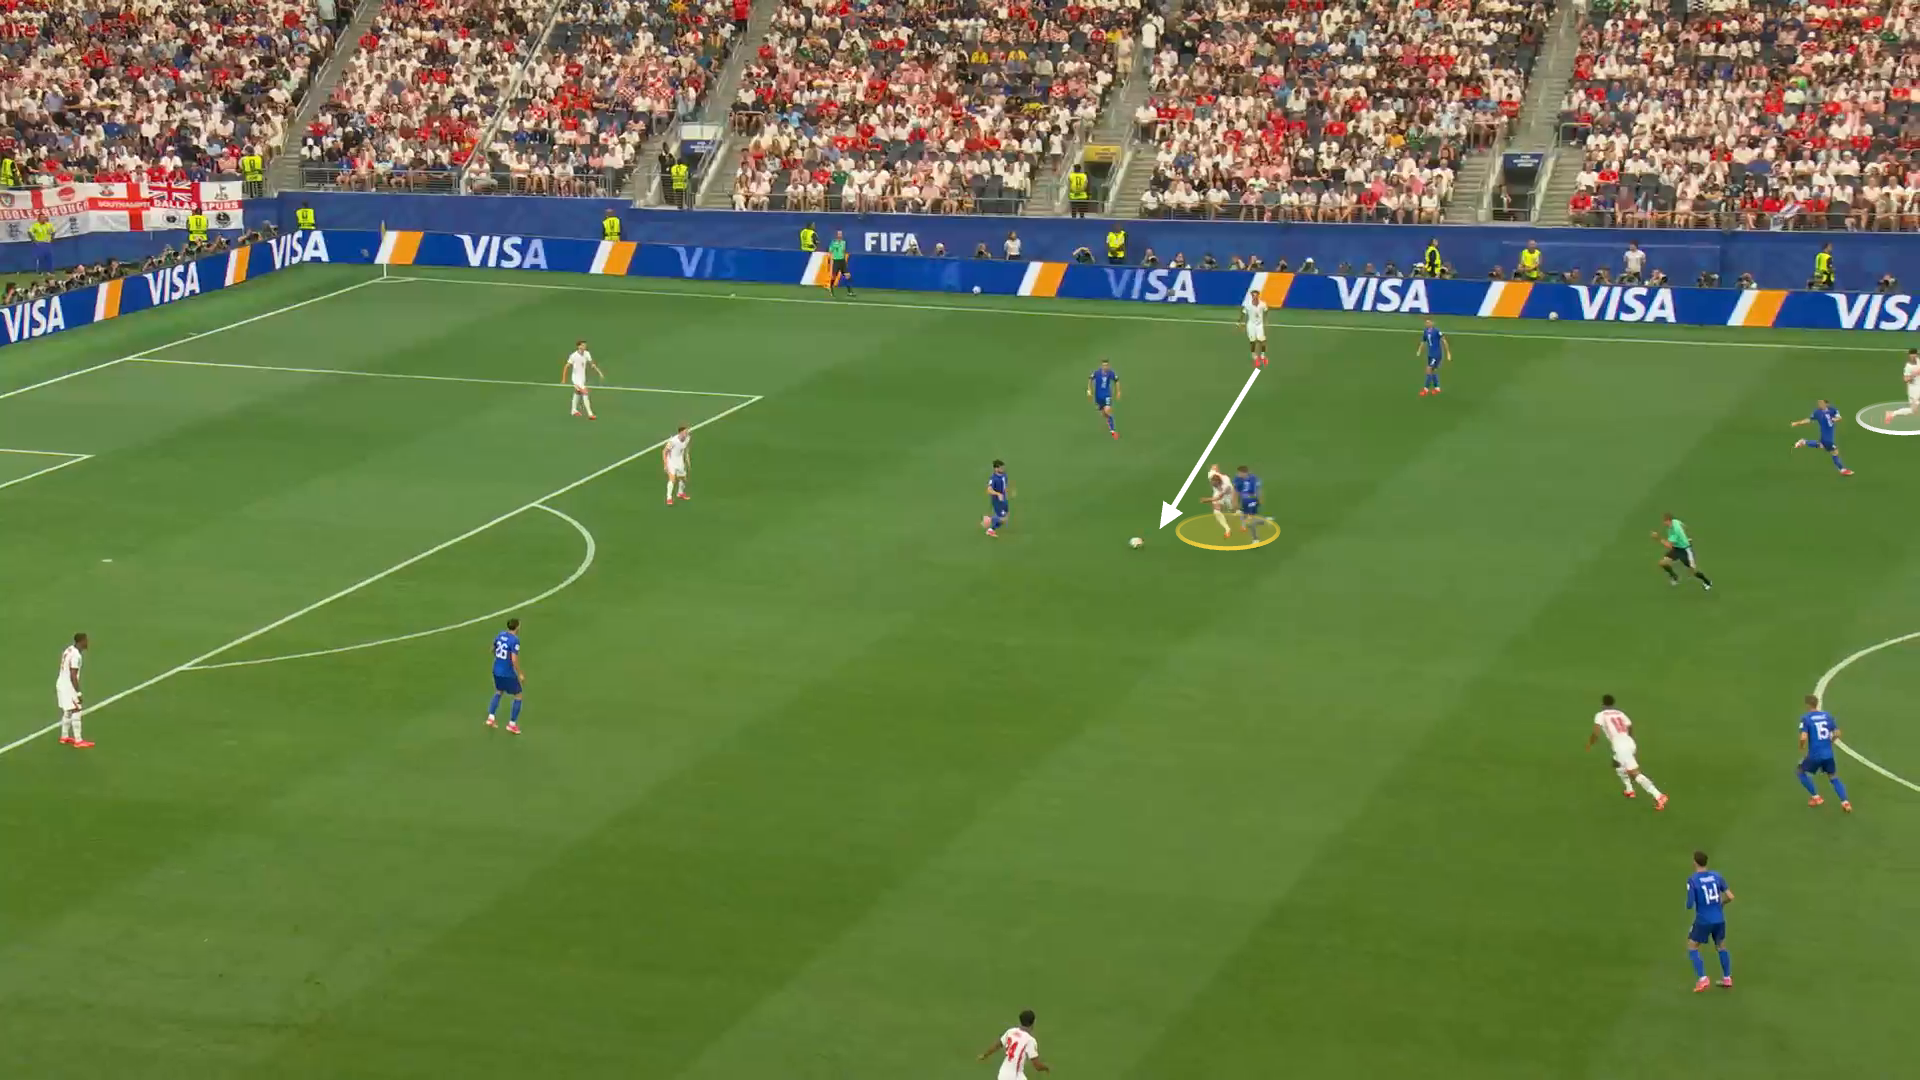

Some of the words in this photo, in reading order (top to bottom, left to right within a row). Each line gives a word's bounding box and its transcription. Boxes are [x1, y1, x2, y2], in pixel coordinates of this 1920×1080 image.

[154, 200, 198, 210] DALLAS
[201, 201, 239, 210] SPURS
[267, 230, 330, 269] VISA
[454, 234, 549, 269] VISA
[865, 232, 920, 252] FIFA
[143, 261, 200, 306] VISA
[1104, 267, 1197, 303] VISA
[1329, 275, 1430, 313] VISA
[0, 295, 65, 343] VISA
[1569, 285, 1677, 323] VISA
[496, 641, 507, 659] 26
[1814, 721, 1830, 740] 15
[1702, 883, 1719, 904] 14
